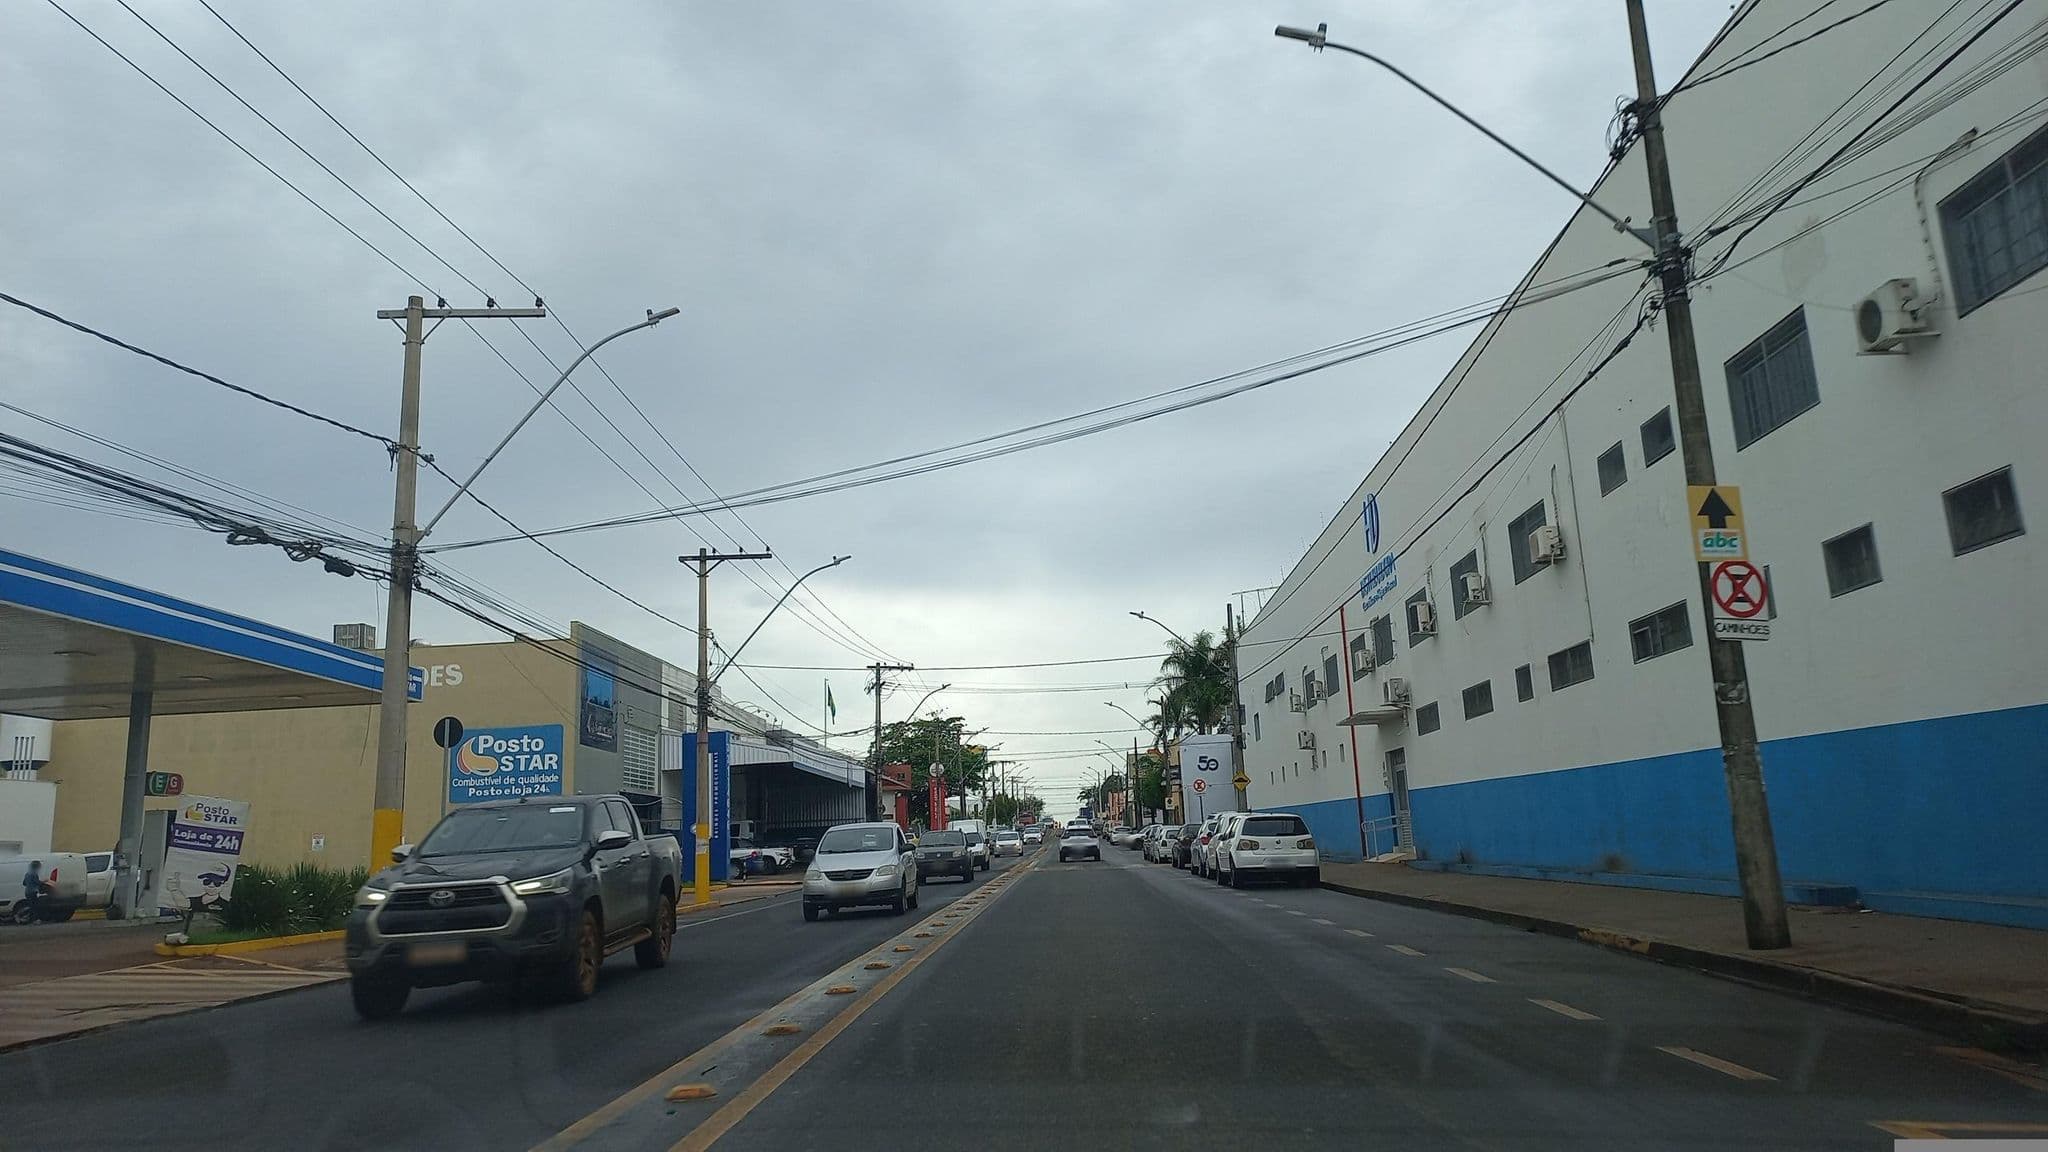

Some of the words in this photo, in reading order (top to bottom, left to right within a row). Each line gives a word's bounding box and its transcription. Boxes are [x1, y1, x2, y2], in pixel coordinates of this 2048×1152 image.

[1703, 532, 1738, 548] abc
[478, 734, 544, 754] Posto
[500, 753, 558, 772] STAR
[170, 776, 178, 788] G
[452, 776, 501, 787] Combustível
[503, 775, 516, 785] de
[518, 773, 559, 786] qualidade
[468, 786, 503, 797] Posto
[511, 785, 532, 796] loja
[195, 803, 229, 815] Posto
[204, 814, 237, 825] STAR
[174, 829, 197, 840] Loja
[200, 832, 213, 841] de
[215, 834, 240, 850] 24h
